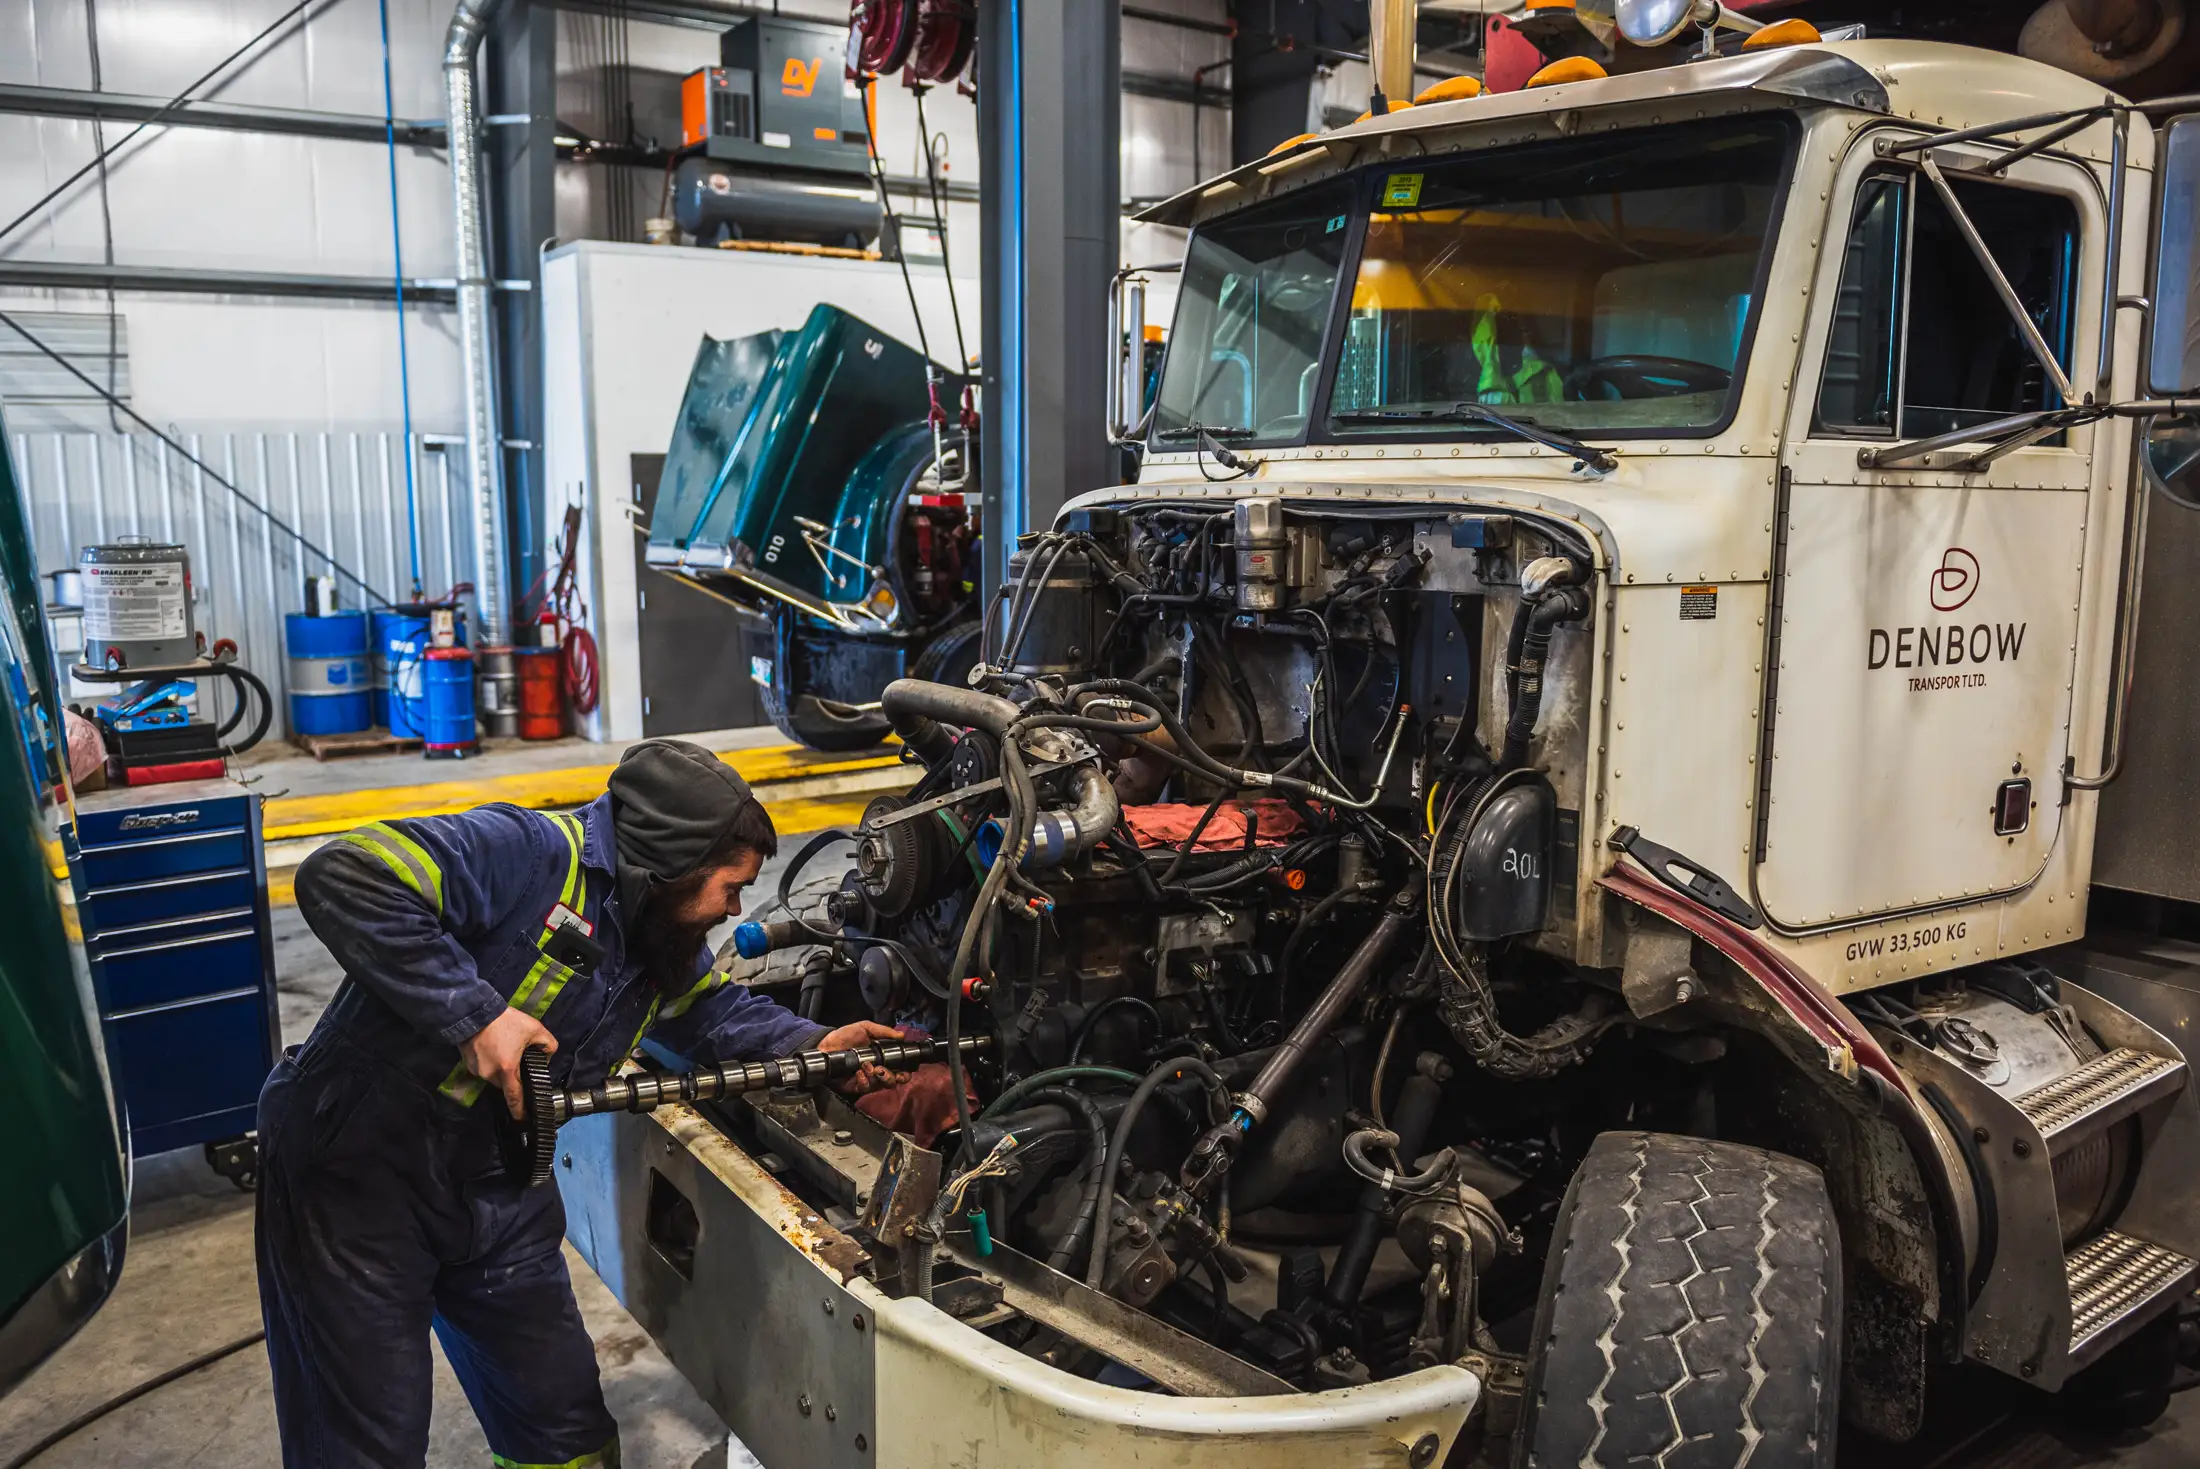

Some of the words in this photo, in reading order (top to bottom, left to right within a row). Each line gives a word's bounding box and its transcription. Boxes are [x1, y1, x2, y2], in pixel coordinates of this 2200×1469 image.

[765, 535, 785, 563] 010
[1867, 622, 2027, 670] DENBOW
[1846, 937, 1885, 961] GVW
[1889, 927, 1941, 953] 33,500
[1946, 922, 1967, 942] KG
